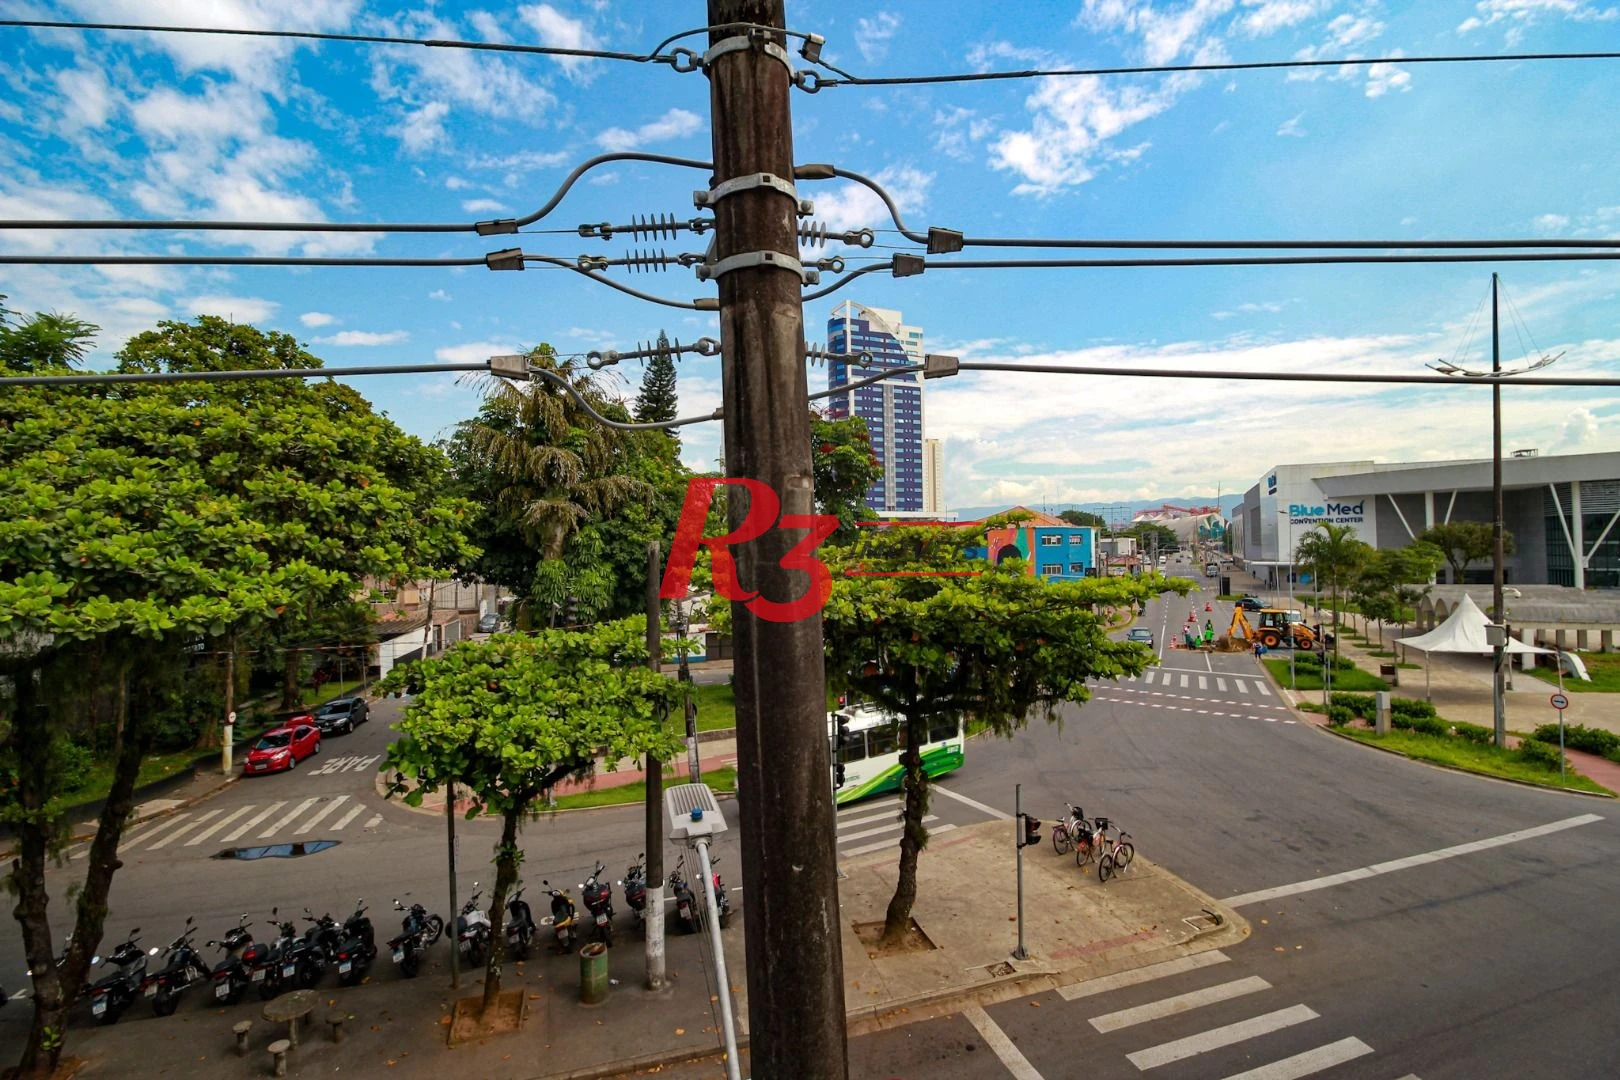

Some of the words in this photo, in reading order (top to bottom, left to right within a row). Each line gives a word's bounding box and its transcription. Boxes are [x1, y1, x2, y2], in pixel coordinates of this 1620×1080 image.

[1289, 504, 1325, 516] Blue
[1327, 499, 1365, 515] Med
[1335, 516, 1364, 524] CENTER
[307, 754, 381, 776] PARE
